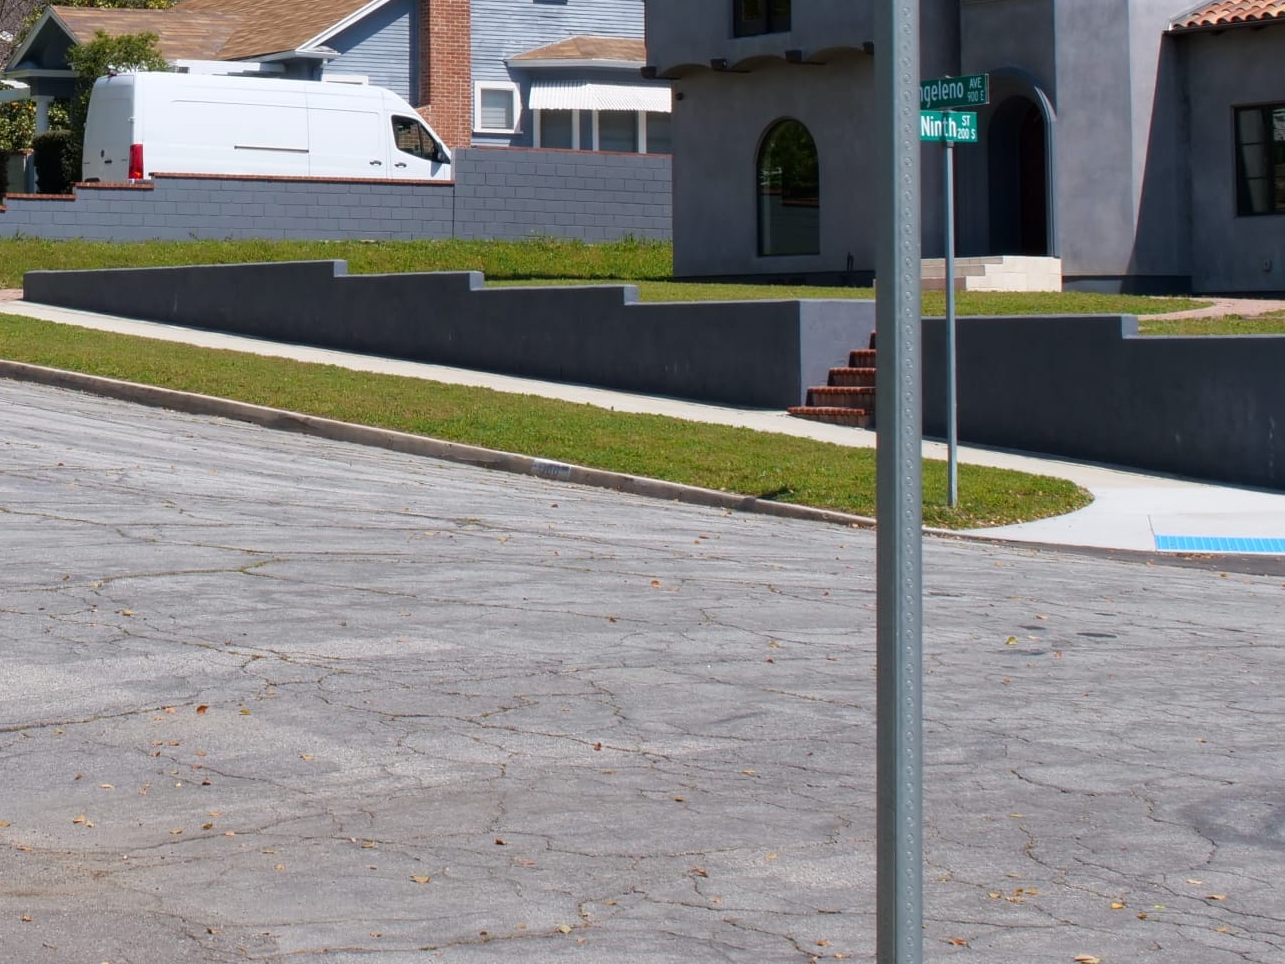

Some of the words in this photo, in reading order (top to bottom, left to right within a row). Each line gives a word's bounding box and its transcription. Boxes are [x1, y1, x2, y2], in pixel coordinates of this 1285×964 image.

[918, 79, 964, 108] ngeleno
[969, 77, 982, 89] AVE
[980, 90, 985, 101] E
[920, 115, 957, 138] Ninth
[961, 115, 971, 126] ST
[957, 128, 970, 140] 200
[970, 128, 976, 140] S
